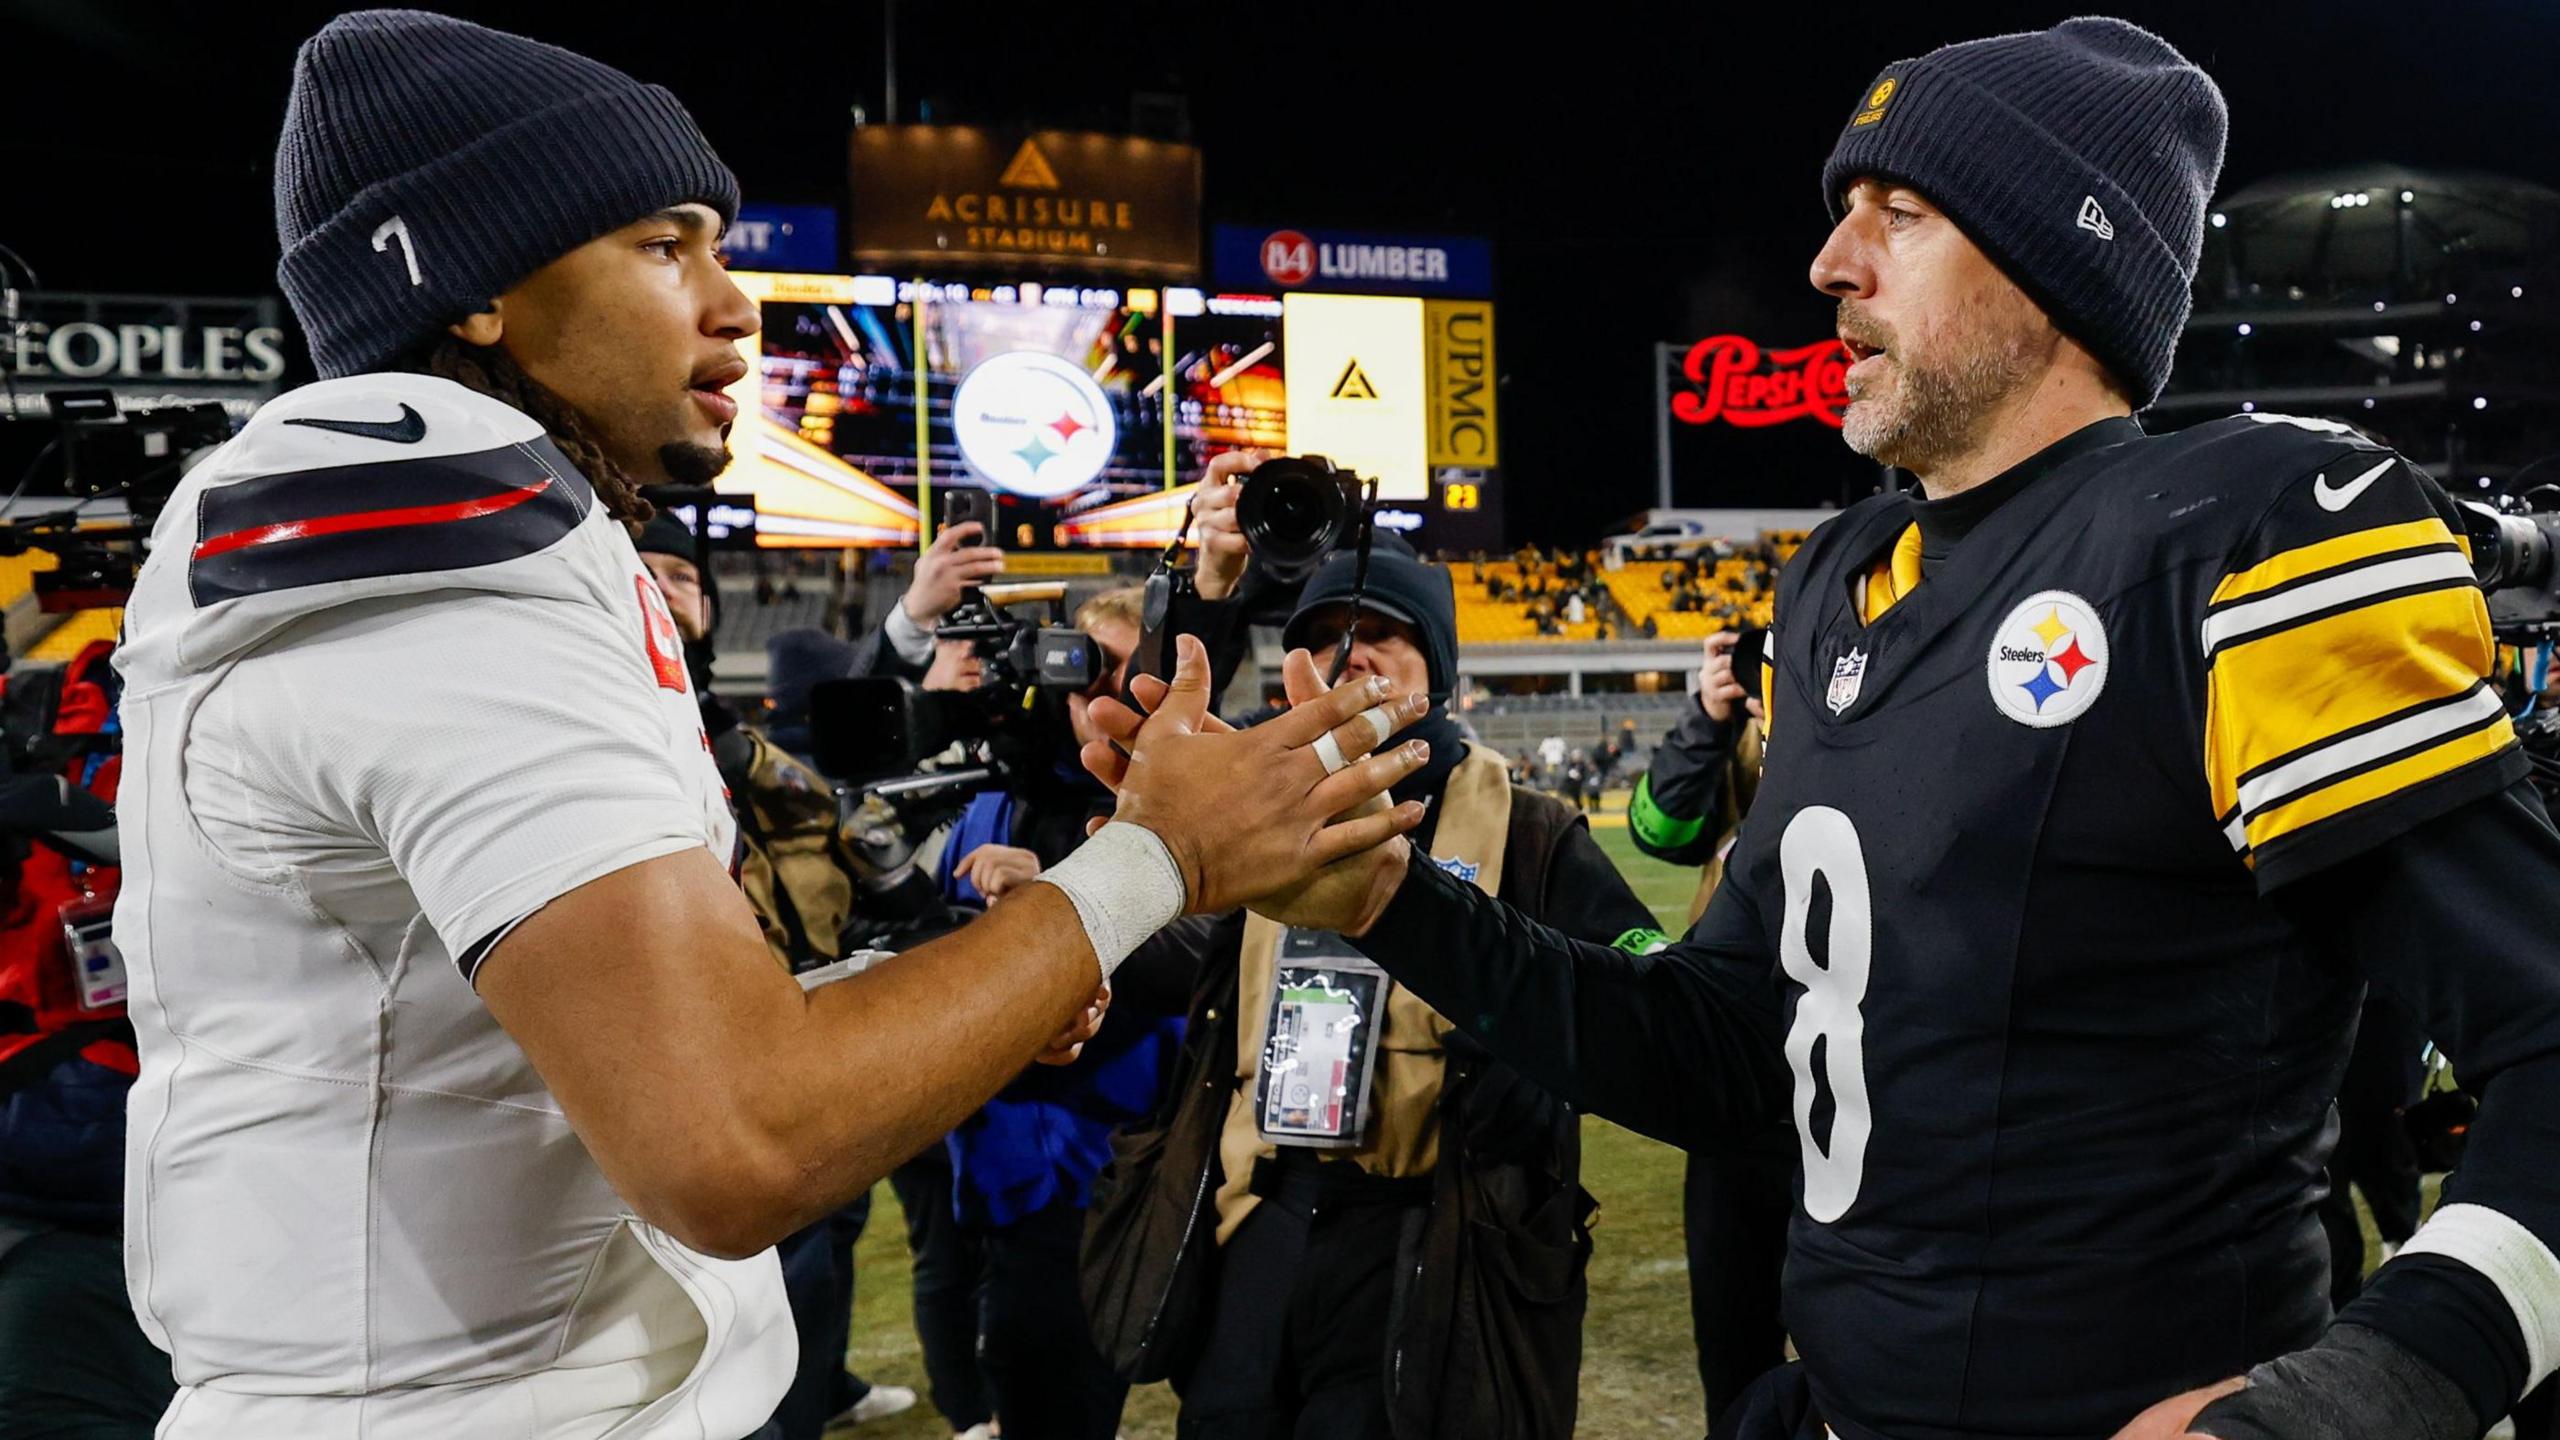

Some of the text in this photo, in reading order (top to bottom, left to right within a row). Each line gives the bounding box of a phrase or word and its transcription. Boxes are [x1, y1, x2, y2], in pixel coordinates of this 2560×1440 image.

[926, 193, 1133, 231] ACRISURE
[372, 214, 423, 286] 7
[966, 227, 1092, 252] STADIUM
[1267, 241, 1448, 281] 84 LUMBER
[1, 321, 285, 382] EOPLES
[1447, 312, 1486, 456] UPMC
[2000, 645, 2045, 663] Steelers
[1780, 805, 1872, 1224] 8
